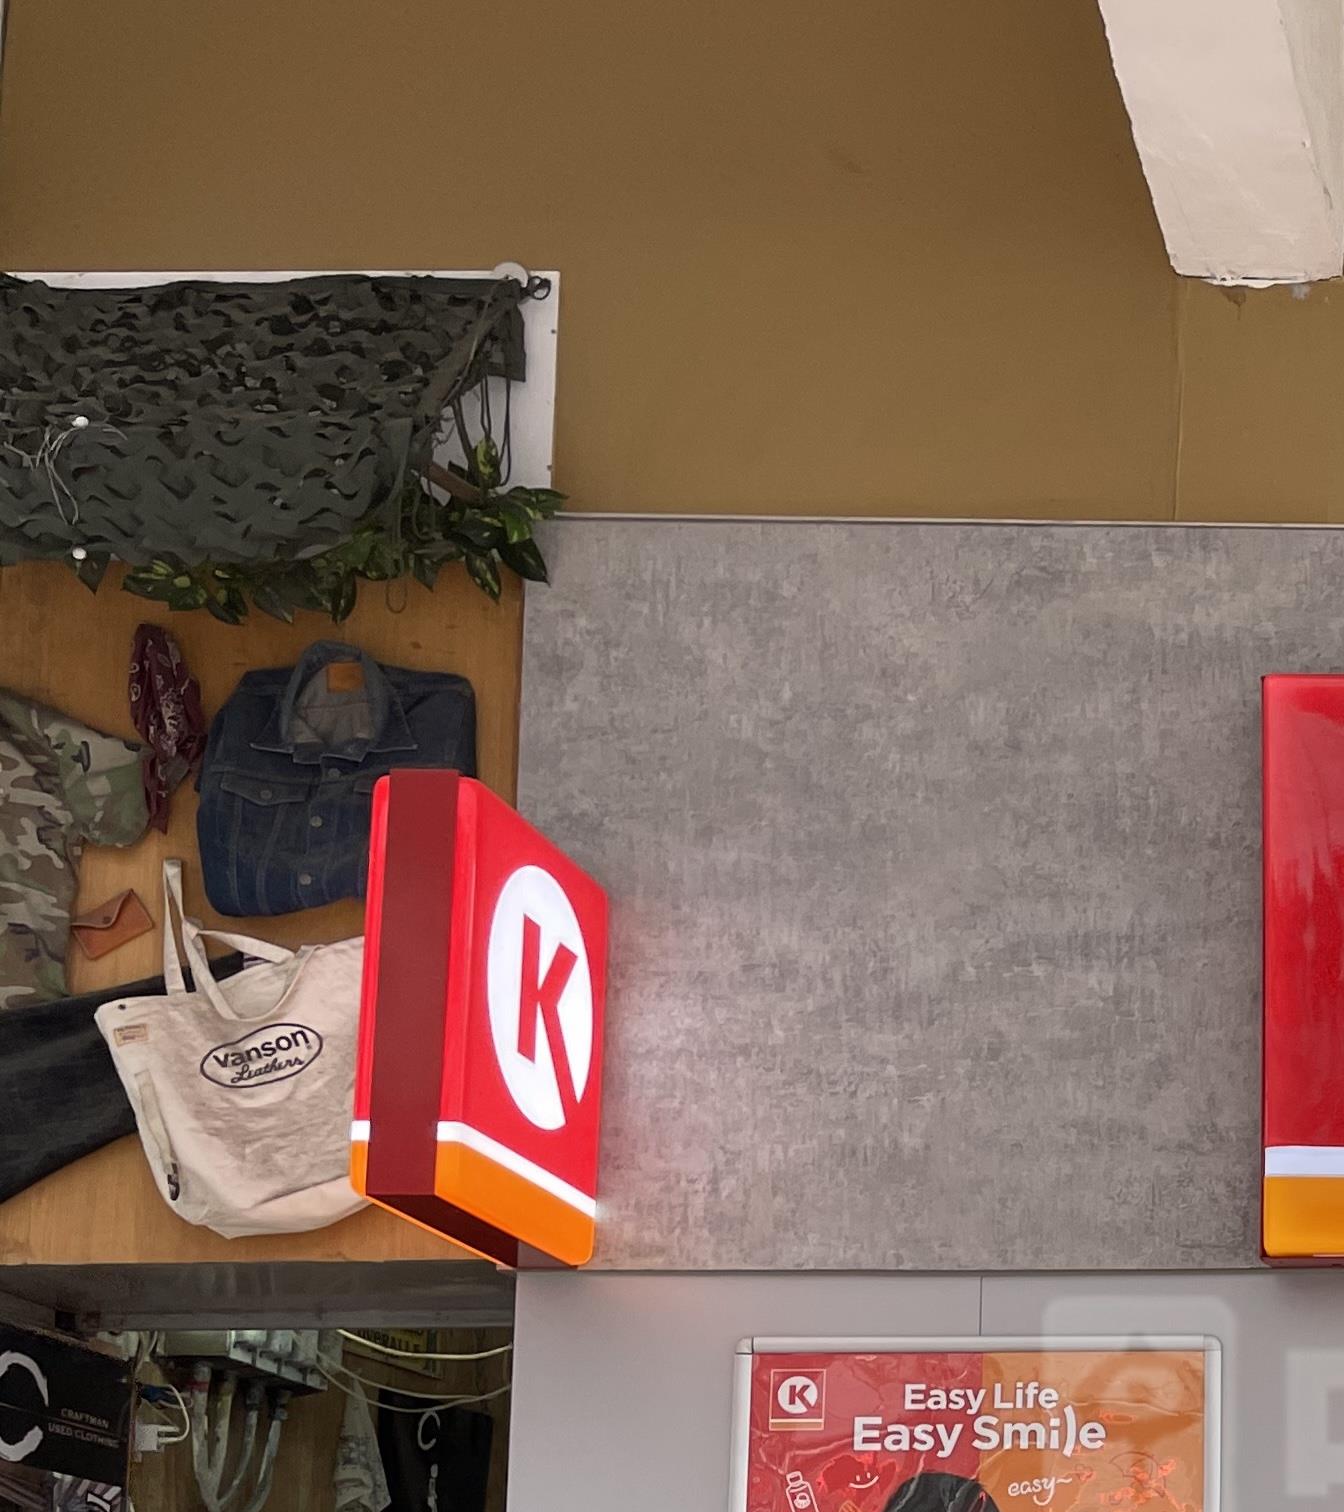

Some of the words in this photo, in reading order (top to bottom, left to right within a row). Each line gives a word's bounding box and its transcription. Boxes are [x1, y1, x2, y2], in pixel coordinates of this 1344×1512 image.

[516, 911, 582, 1124] K
[212, 1029, 311, 1068] vanson
[230, 1056, 304, 1083] Leathers
[904, 1383, 987, 1415] Easy
[993, 1382, 1059, 1410] Life
[48, 1421, 74, 1438] USED
[74, 1426, 120, 1449] CLOTHING
[60, 1407, 110, 1430] CRAFTMAN
[853, 1416, 964, 1458] Easy
[972, 1405, 1106, 1457] Smile
